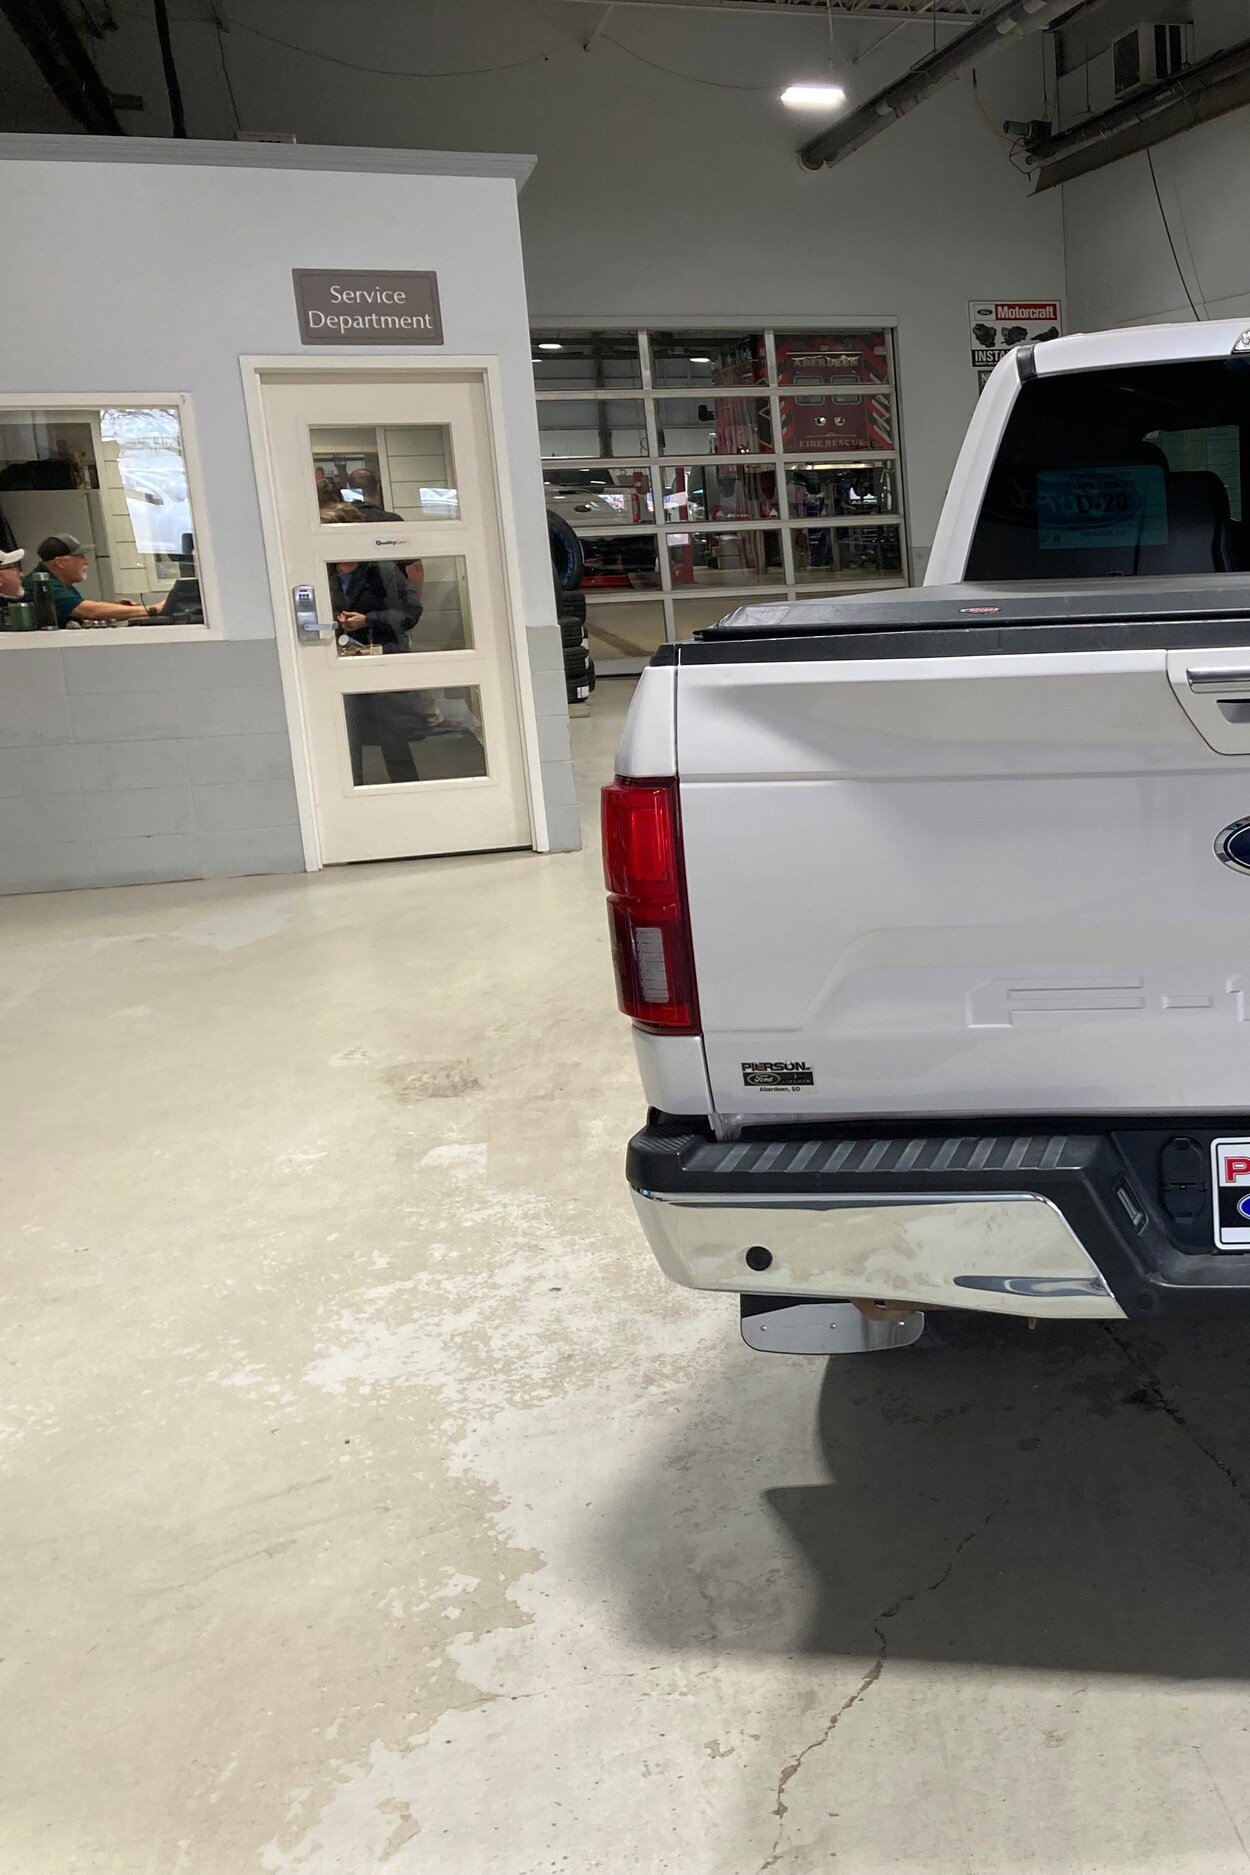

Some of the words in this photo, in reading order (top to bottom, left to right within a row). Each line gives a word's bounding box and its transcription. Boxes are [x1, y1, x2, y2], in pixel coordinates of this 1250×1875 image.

[330, 285, 406, 304] Service
[997, 306, 1056, 319] Motorcraft
[308, 310, 433, 334] Department
[974, 350, 1007, 362] INSTA
[793, 358, 858, 367] ABERDEEN
[799, 440, 824, 448] FIRE
[825, 438, 864, 447] RESCUE
[741, 1062, 806, 1072] PIERSON
